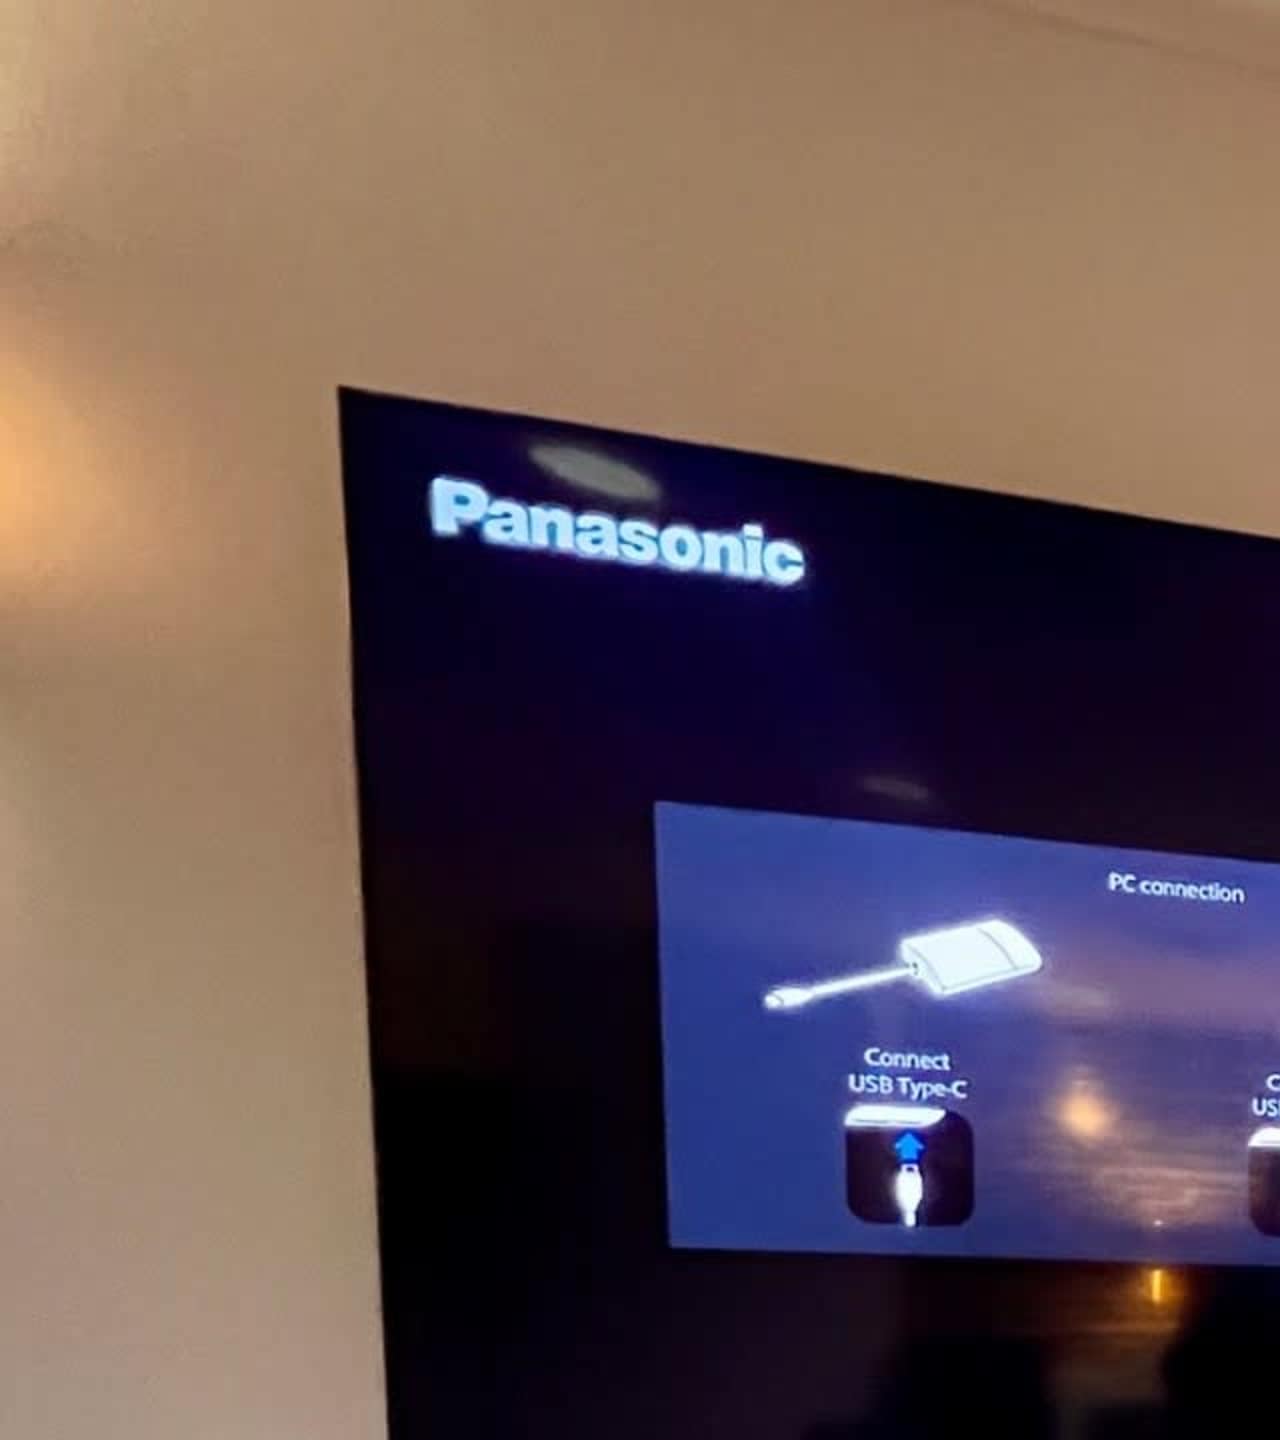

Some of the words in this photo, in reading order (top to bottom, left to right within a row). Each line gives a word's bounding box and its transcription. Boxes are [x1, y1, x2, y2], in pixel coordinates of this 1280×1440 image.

[430, 475, 806, 586] Panasonic
[1107, 872, 1136, 893] PC
[1140, 878, 1245, 903] connection
[863, 1047, 951, 1071] Connect
[848, 1073, 894, 1095] USB
[898, 1075, 968, 1102] Type-C
